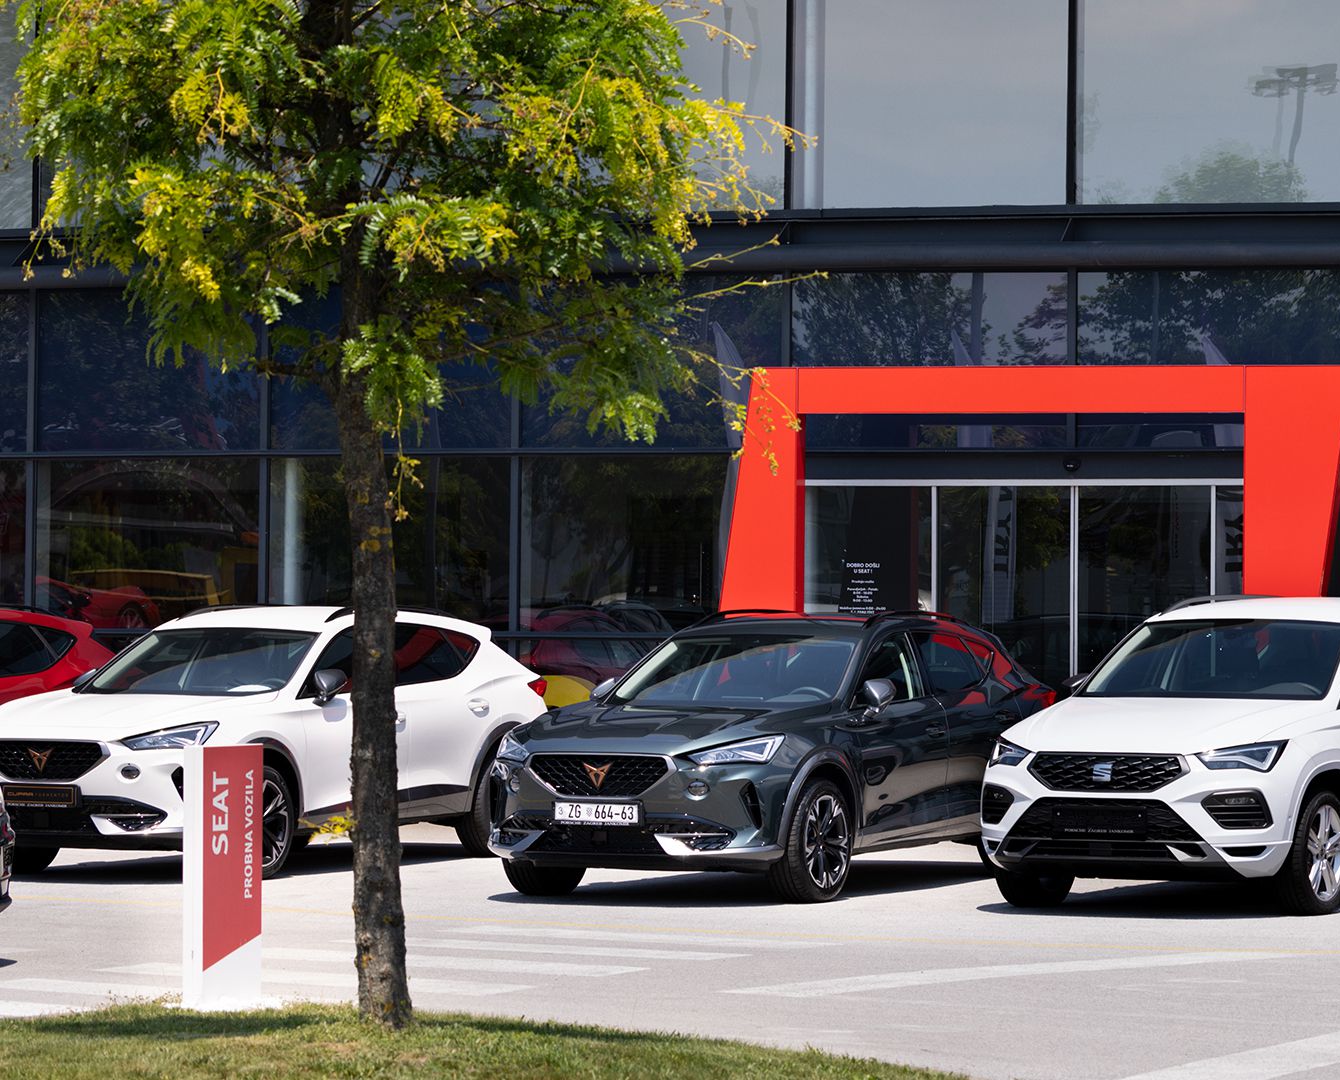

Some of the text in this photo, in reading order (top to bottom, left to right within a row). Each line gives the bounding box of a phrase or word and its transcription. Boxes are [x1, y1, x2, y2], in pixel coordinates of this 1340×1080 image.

[212, 771, 229, 855] SEAT
[244, 769, 254, 898] PROBNA VOZILA
[568, 804, 581, 818] ZG
[594, 804, 634, 820] 664-63
